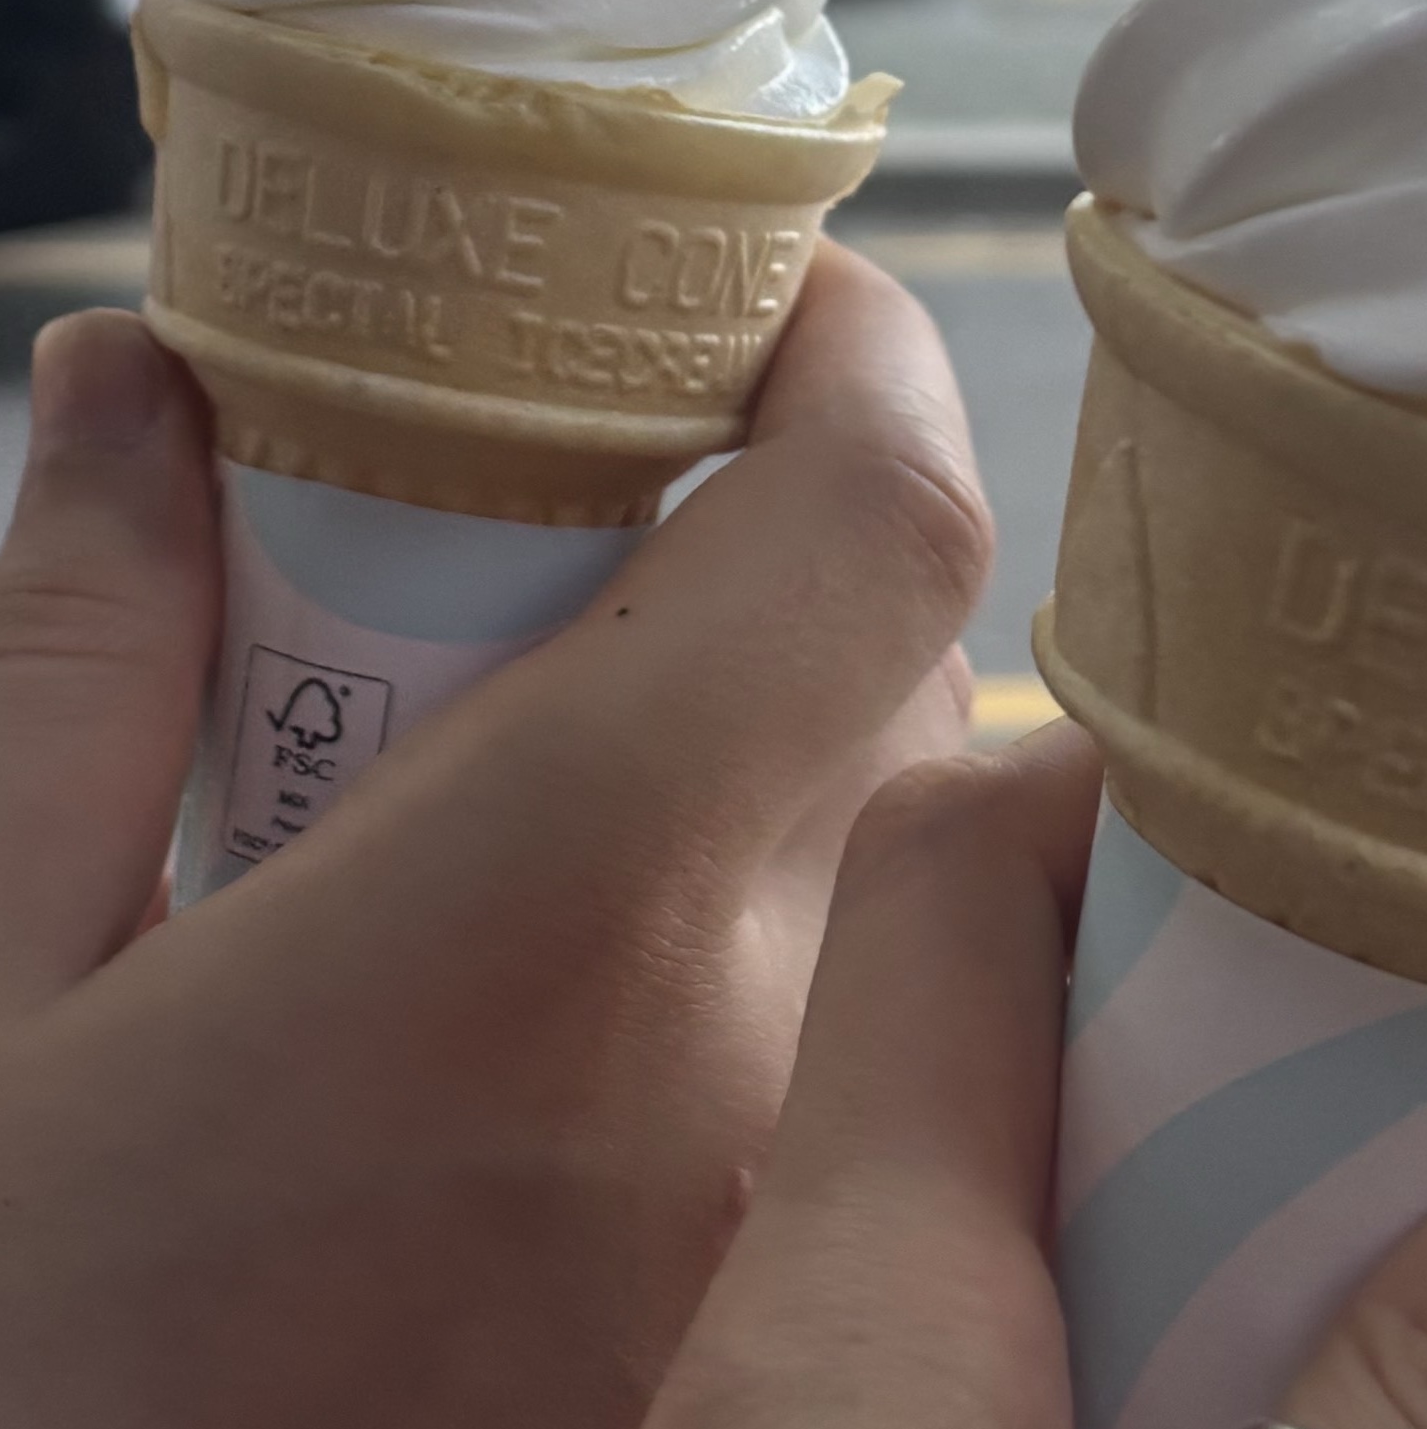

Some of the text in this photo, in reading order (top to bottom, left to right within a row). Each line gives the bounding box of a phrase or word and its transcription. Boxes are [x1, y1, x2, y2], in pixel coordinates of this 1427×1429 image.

[218, 137, 803, 317] DELUXE CONE
[273, 743, 336, 782] FSC
